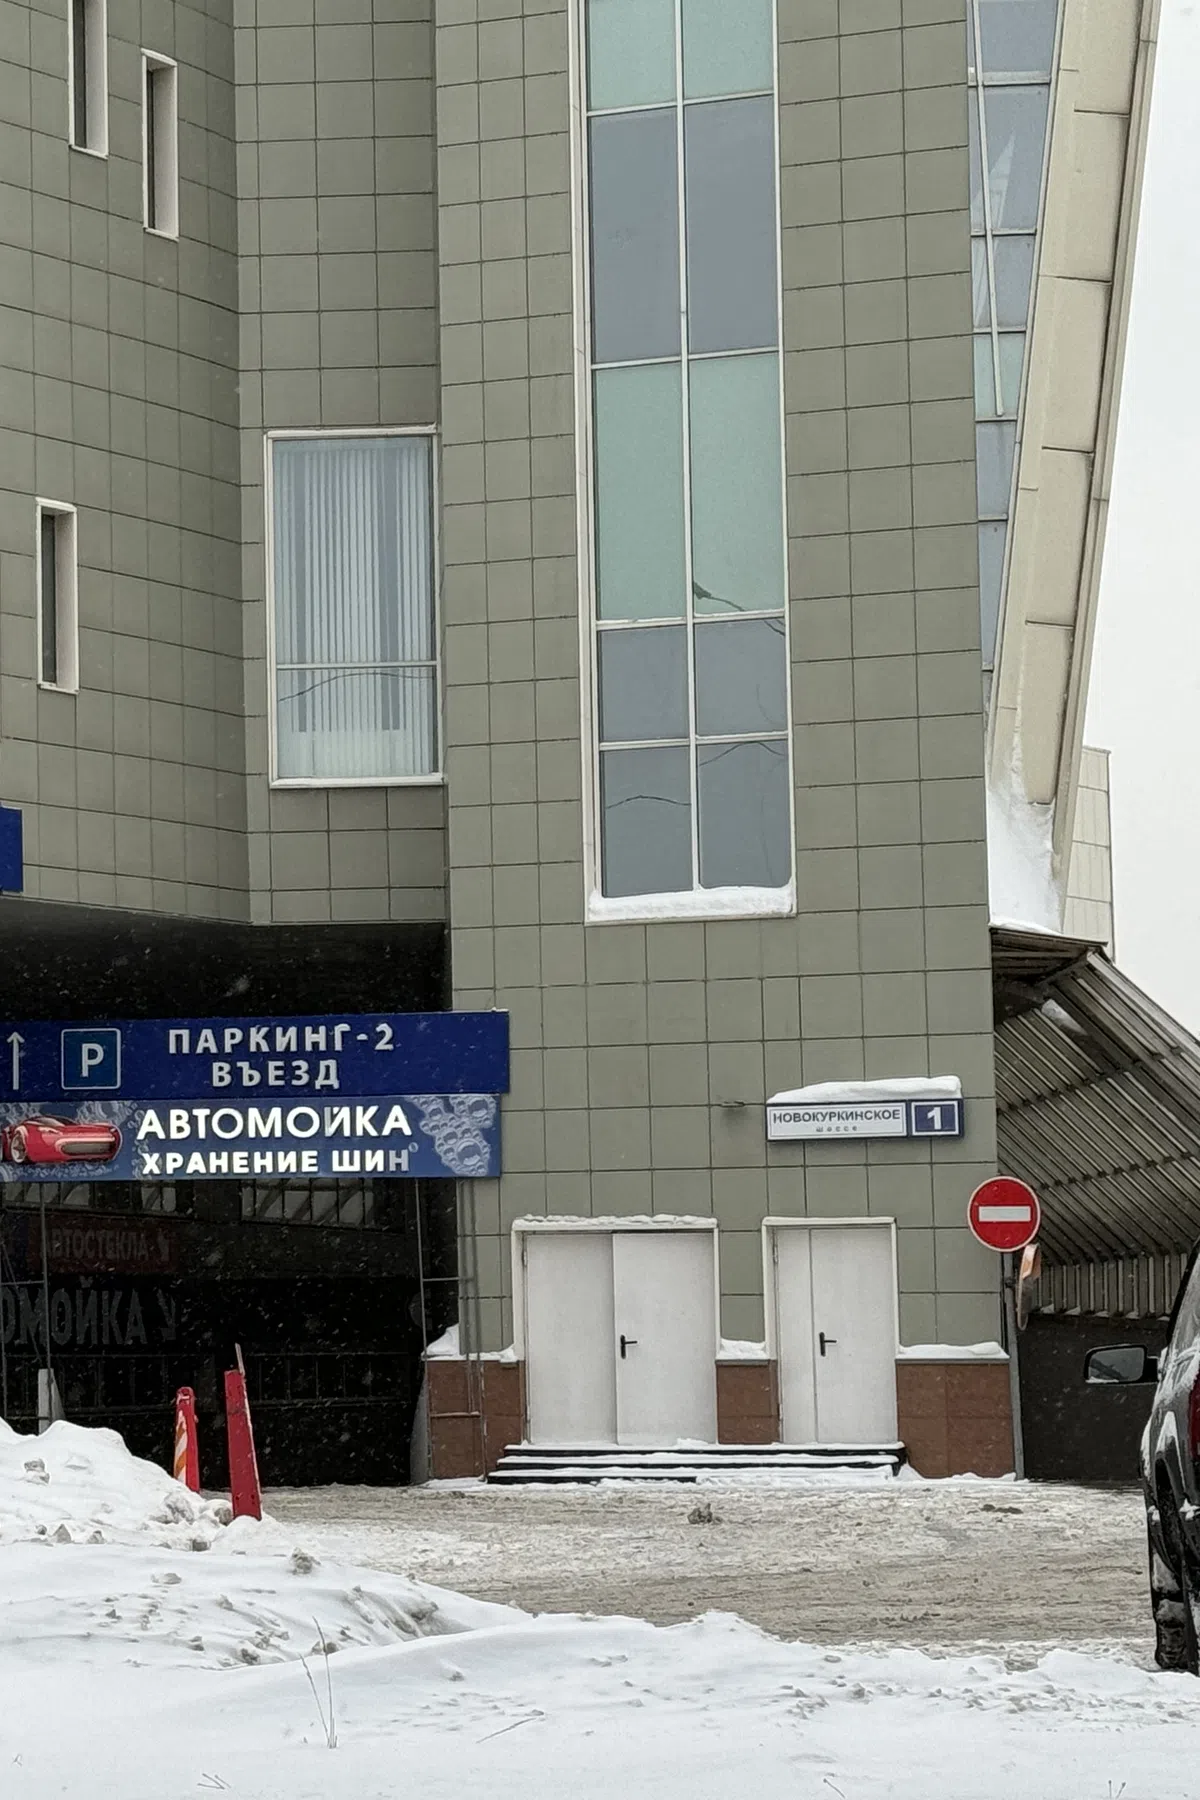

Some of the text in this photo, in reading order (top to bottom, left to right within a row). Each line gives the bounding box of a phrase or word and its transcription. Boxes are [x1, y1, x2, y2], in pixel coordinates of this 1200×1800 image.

[80, 1043, 104, 1078] P
[211, 1059, 340, 1089] ВЪЕЗД
[137, 1104, 412, 1140] АВТОМОЙКА
[773, 1106, 942, 1130] НОВОКУРКИНСКОЕ 1
[142, 1148, 409, 1175] ХРАНЕНИЕ ШИН
